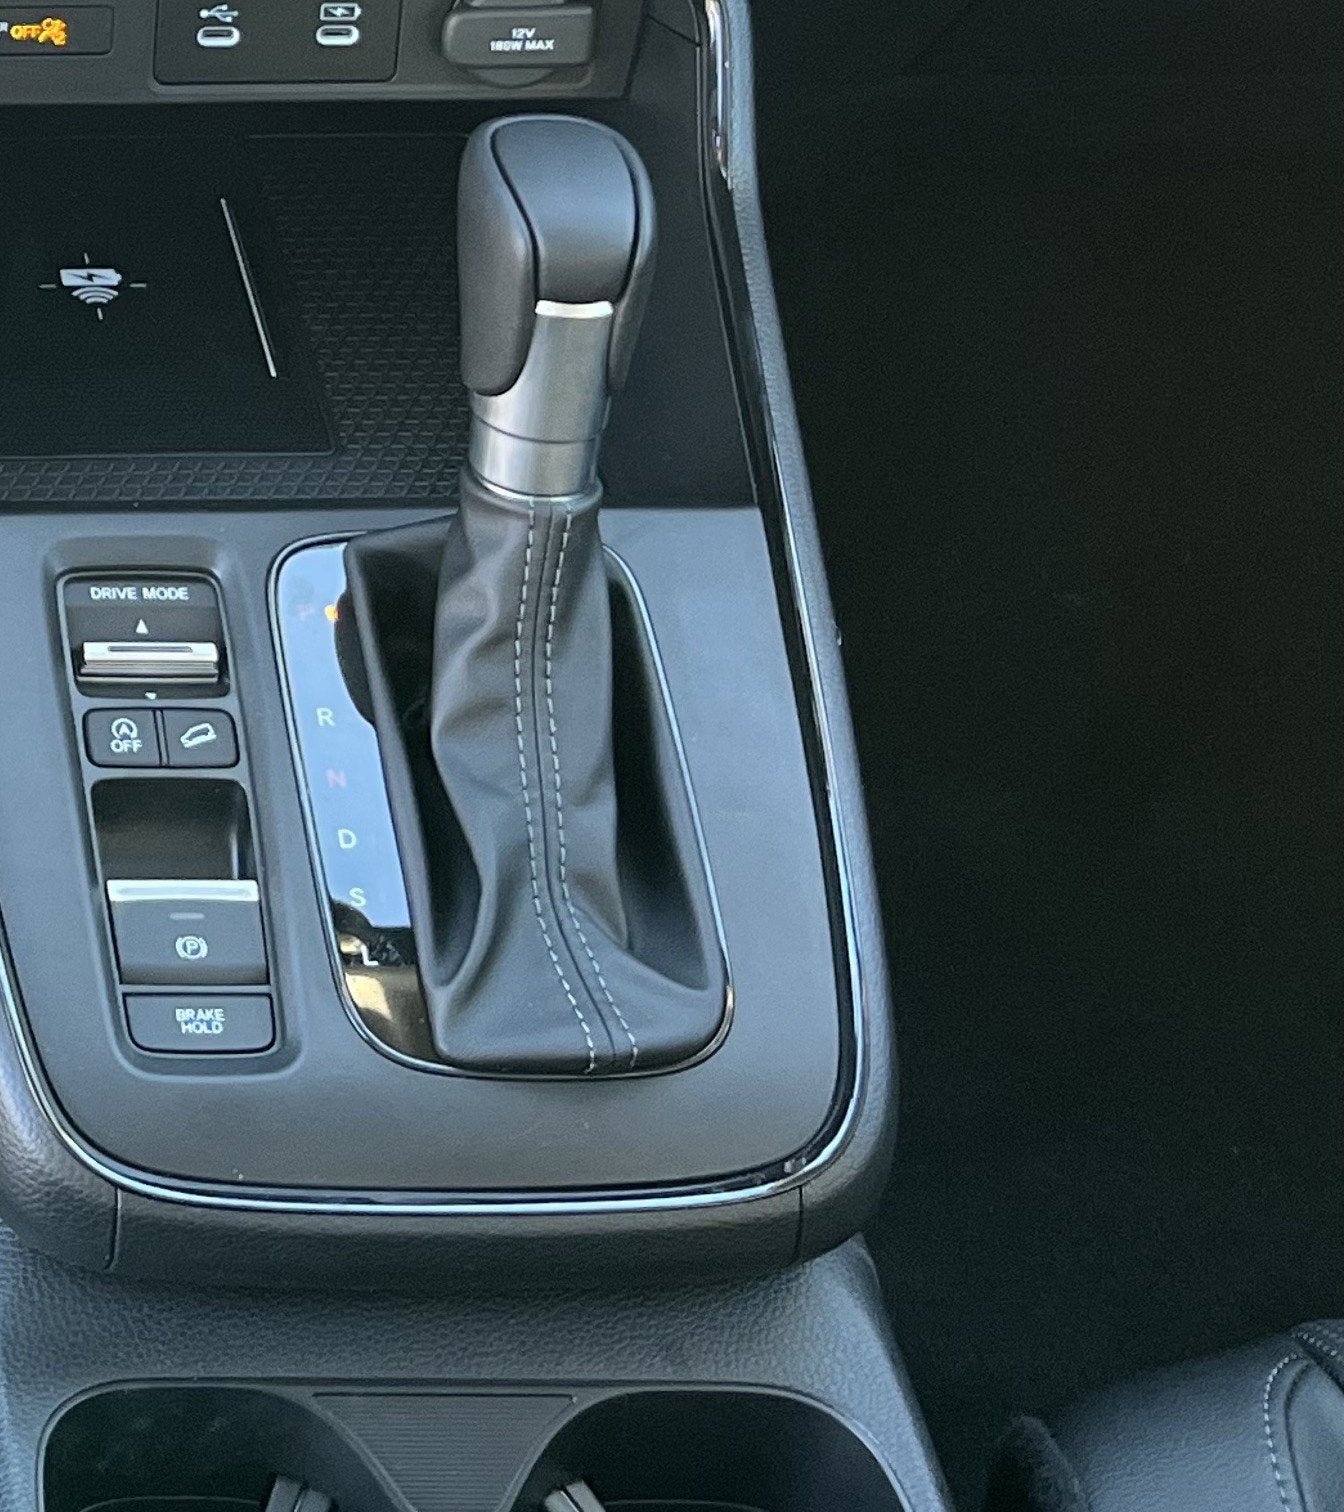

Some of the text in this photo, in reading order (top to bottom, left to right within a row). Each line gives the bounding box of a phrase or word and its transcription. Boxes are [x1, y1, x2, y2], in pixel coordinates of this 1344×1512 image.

[9, 25, 43, 40] OFF
[512, 27, 537, 39] 12V
[525, 39, 555, 51] MAX
[90, 587, 189, 601] DRIVE MODE
[317, 707, 335, 727] R
[110, 738, 143, 754] OFF
[326, 768, 347, 789] N
[337, 829, 357, 850] D
[348, 887, 367, 908] S
[361, 944, 379, 966] L
[175, 1008, 225, 1022] BRAKE
[180, 1021, 224, 1035] HOLD
